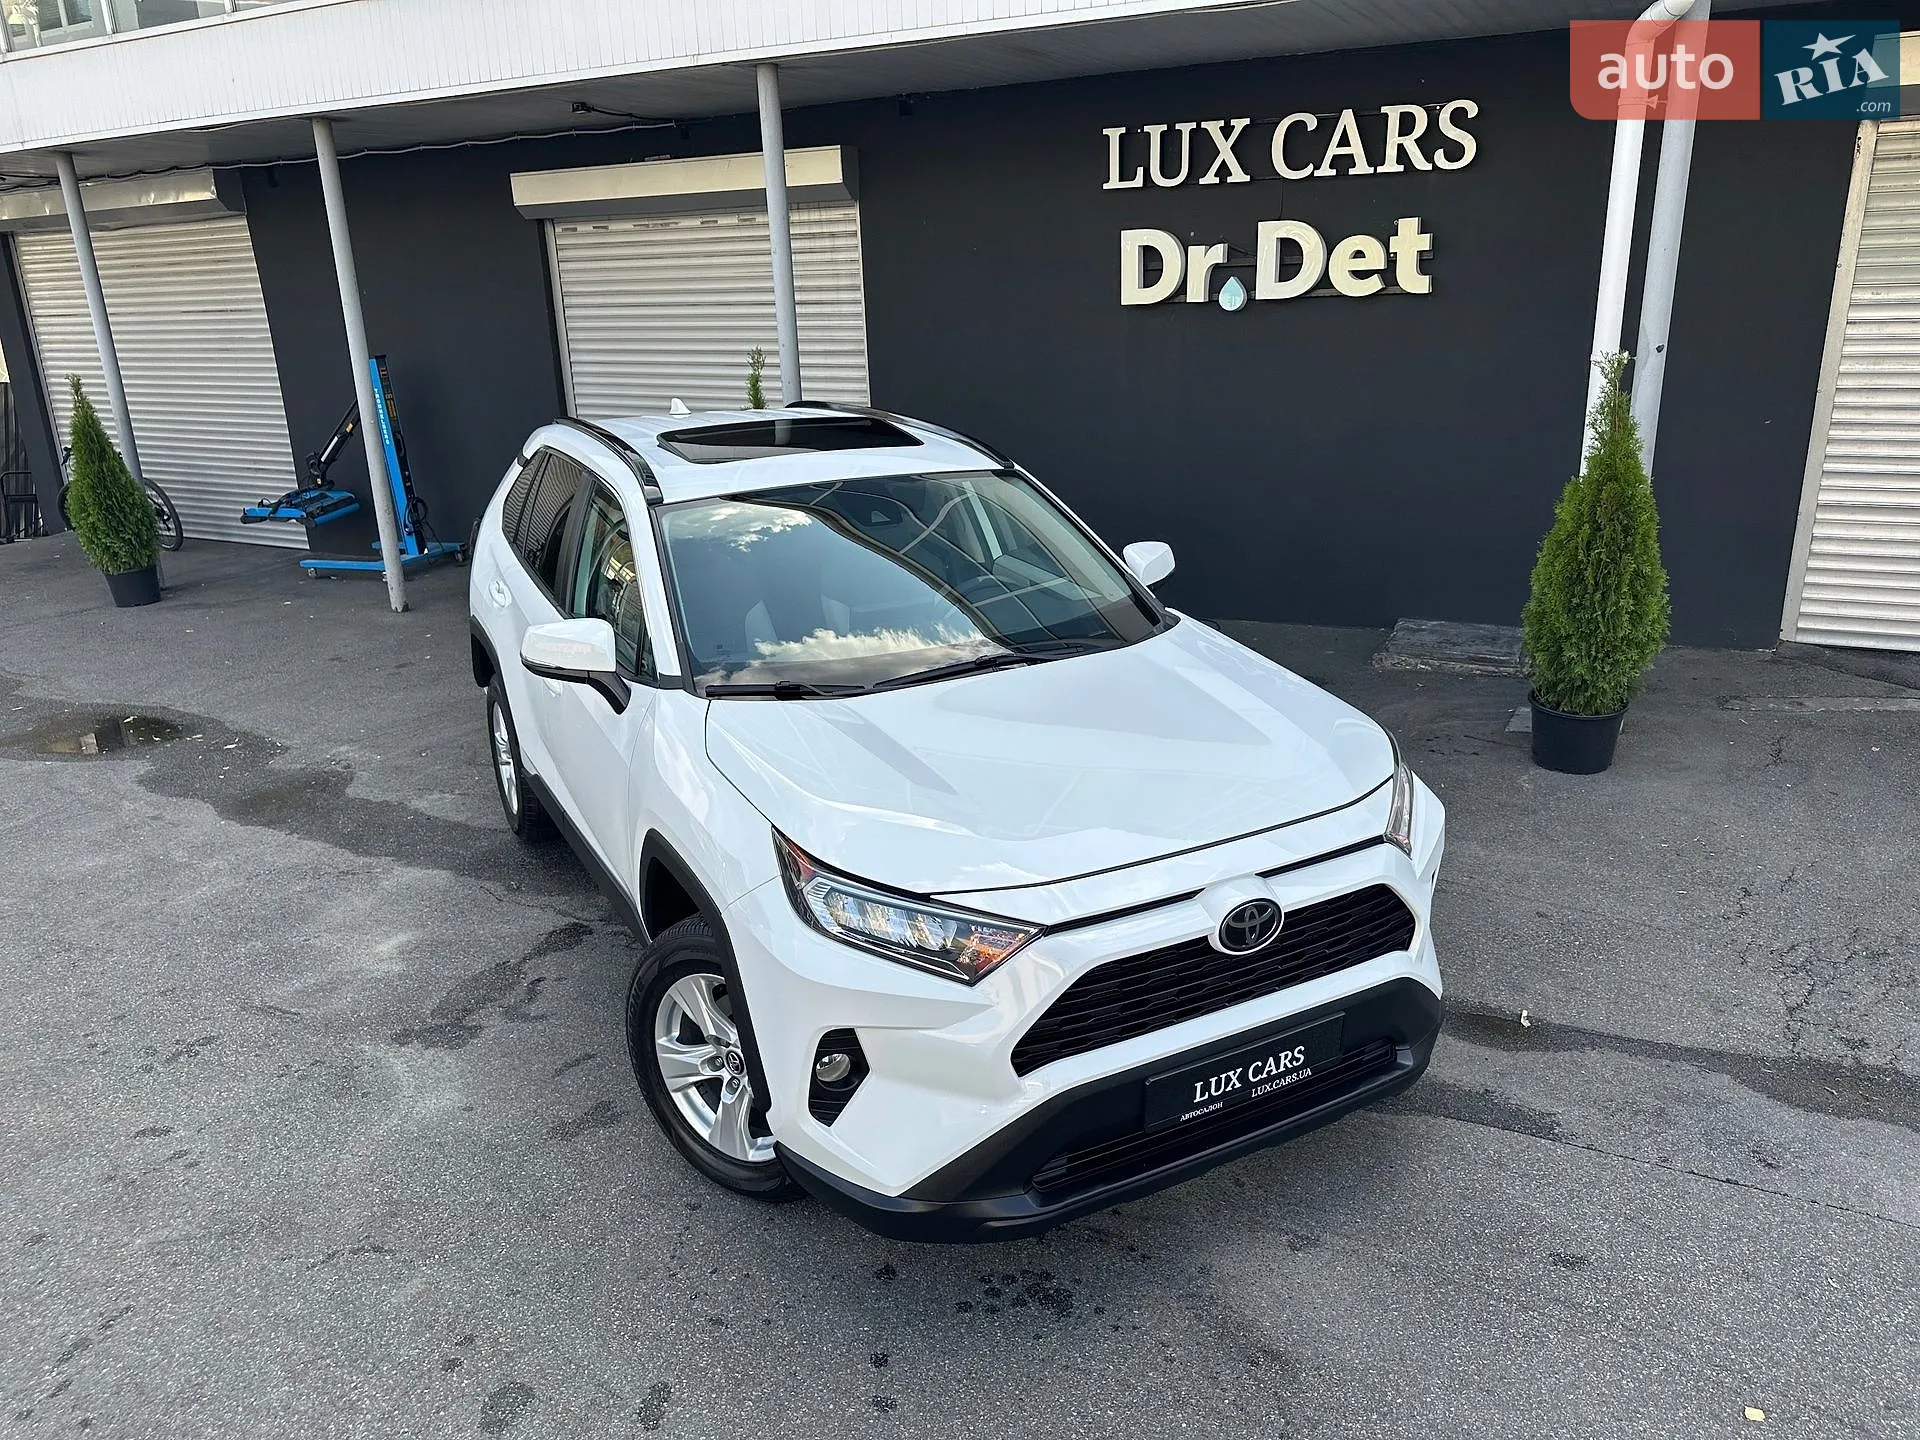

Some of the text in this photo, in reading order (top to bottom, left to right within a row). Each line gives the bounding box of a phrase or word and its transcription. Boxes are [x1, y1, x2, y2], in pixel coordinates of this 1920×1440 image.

[1102, 99, 1479, 190] LUX CARS
[1193, 1046, 1305, 1103] LUX CARS
[1251, 1067, 1312, 1098] LUX.CARS.UA
[1179, 1101, 1223, 1122] АВТОСАЛОН
